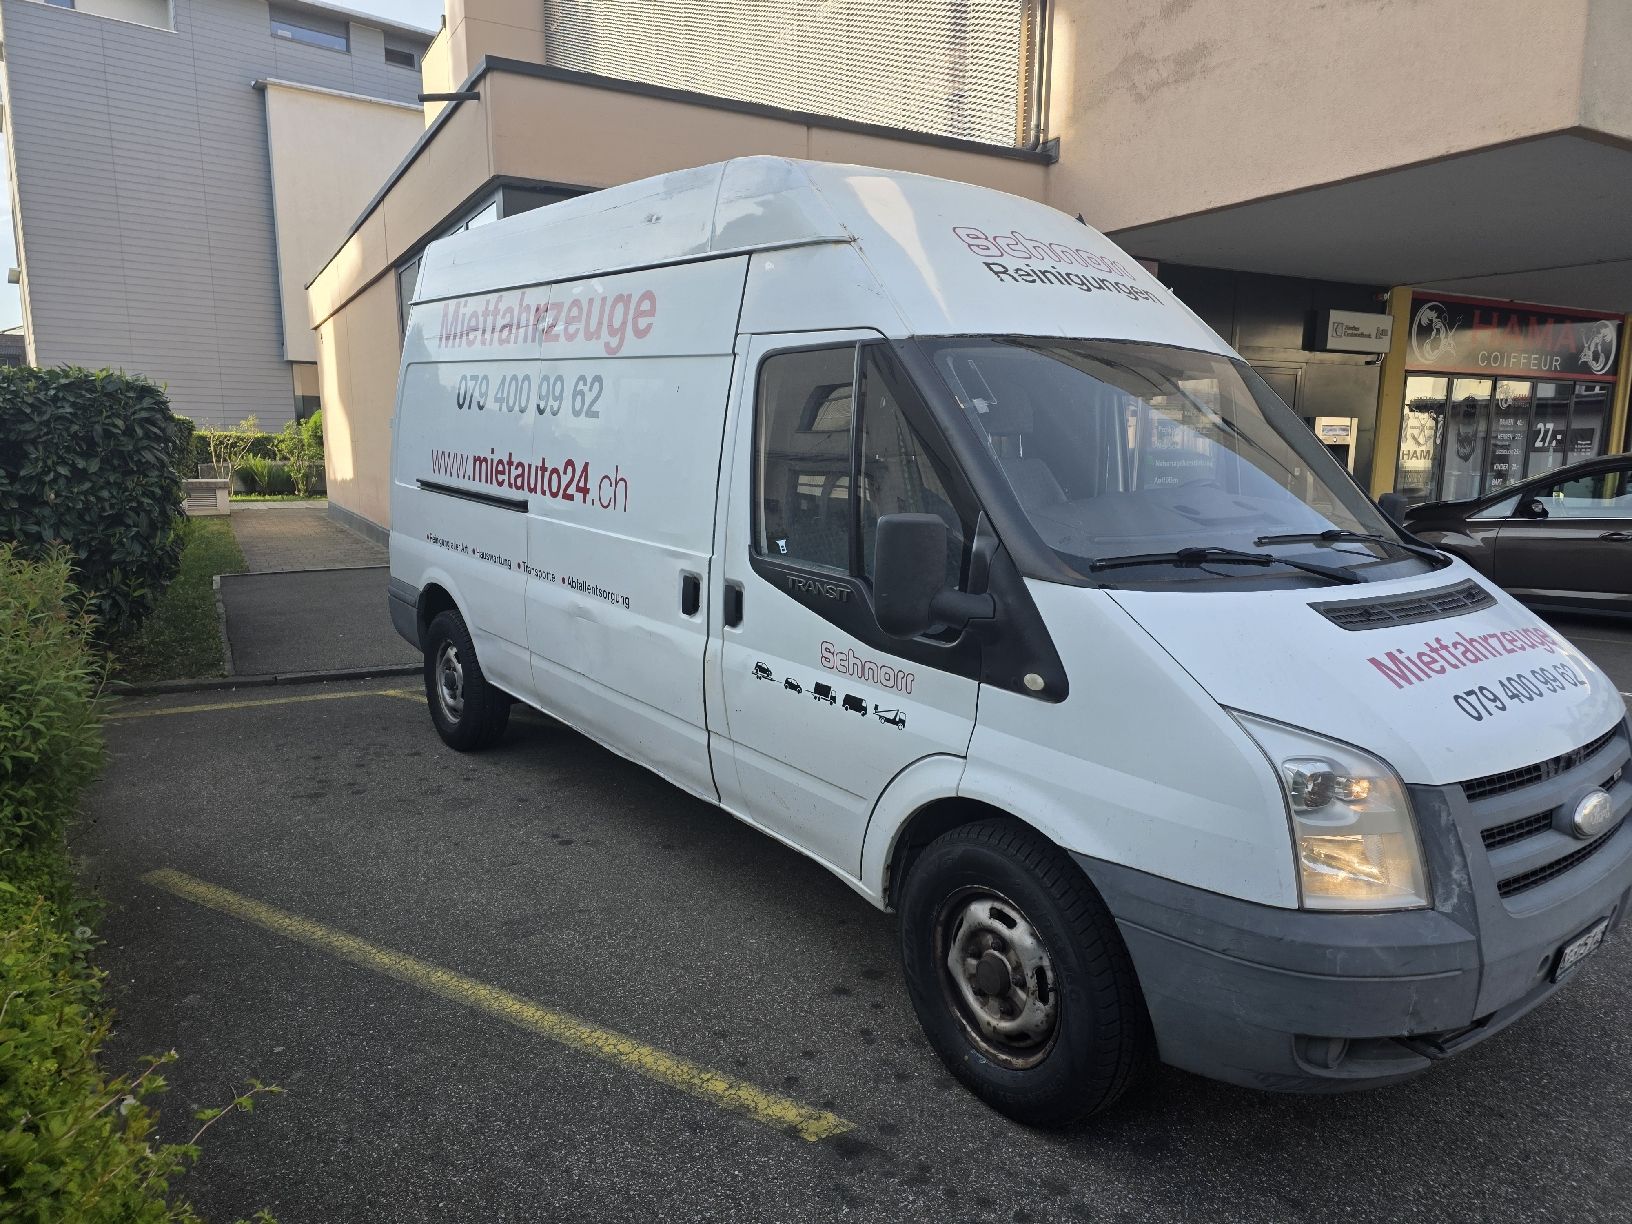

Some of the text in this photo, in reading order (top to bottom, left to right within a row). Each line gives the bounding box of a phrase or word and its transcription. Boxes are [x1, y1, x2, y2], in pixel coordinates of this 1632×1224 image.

[982, 261, 1165, 306] Reinigungen
[437, 289, 657, 356] Mietfahrzeuge
[1471, 310, 1577, 353] HAMA
[1478, 351, 1561, 371] COIFFEUR
[456, 373, 604, 419] 079 400 99 62
[431, 447, 628, 512] www.mietauto24.ch
[567, 575, 630, 609] Abfallentsorgung
[786, 575, 852, 602] TRANSIT
[820, 640, 915, 694] Schnorr
[1366, 627, 1558, 689] Mietfahrzeuge
[1453, 662, 1587, 721] 079 400 99 62
